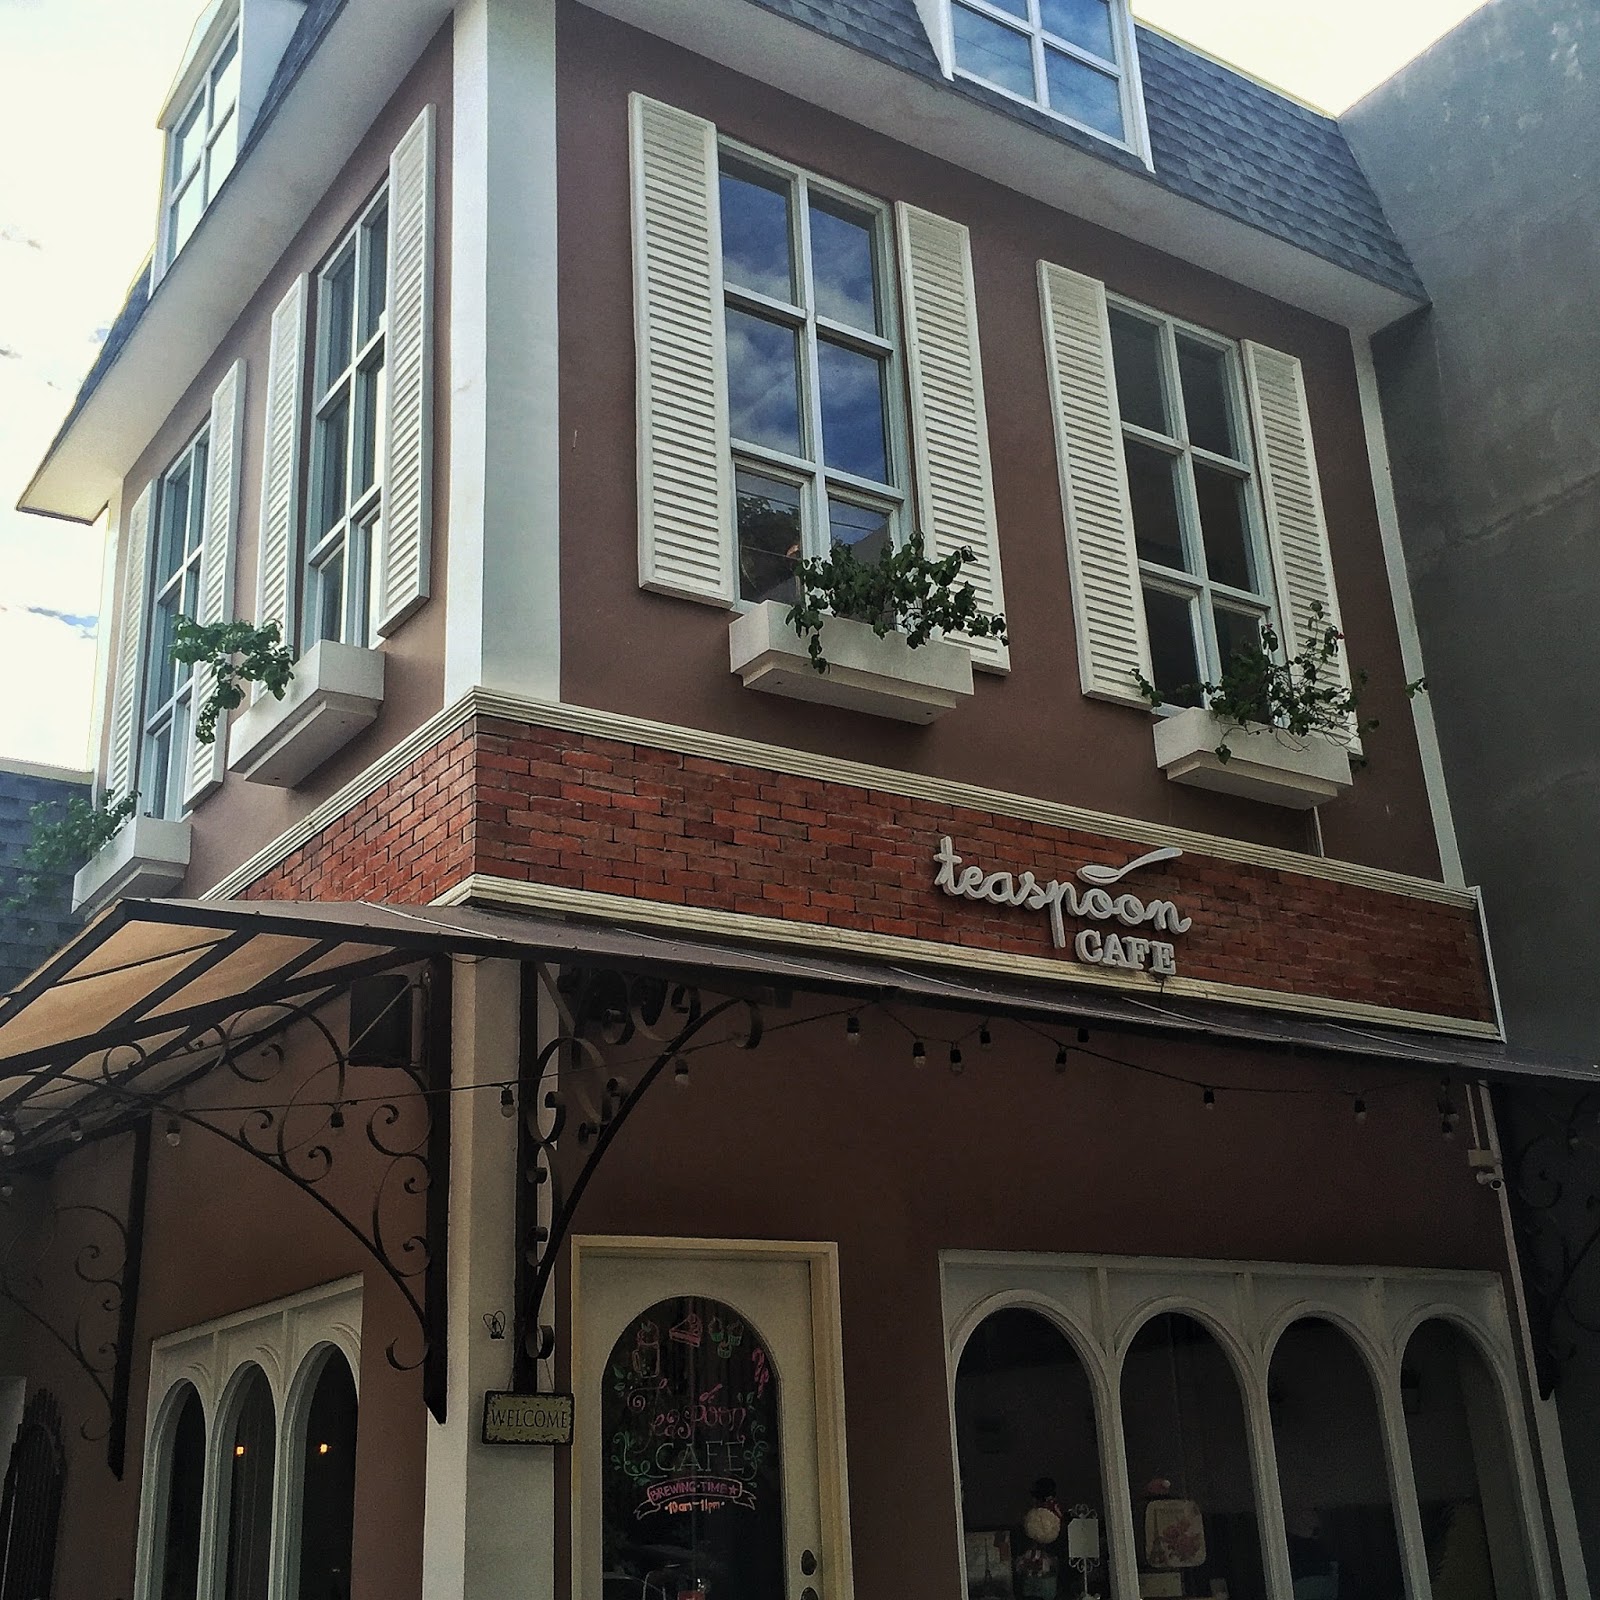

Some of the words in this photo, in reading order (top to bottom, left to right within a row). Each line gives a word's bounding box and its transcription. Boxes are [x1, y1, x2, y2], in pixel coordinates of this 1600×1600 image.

[933, 836, 1192, 949] teaspoon
[1075, 929, 1177, 976] CAFE
[491, 1409, 568, 1428] WELCOME
[655, 1439, 745, 1475] CAFE
[649, 1481, 696, 1501] BREWING
[700, 1481, 728, 1494] TIME
